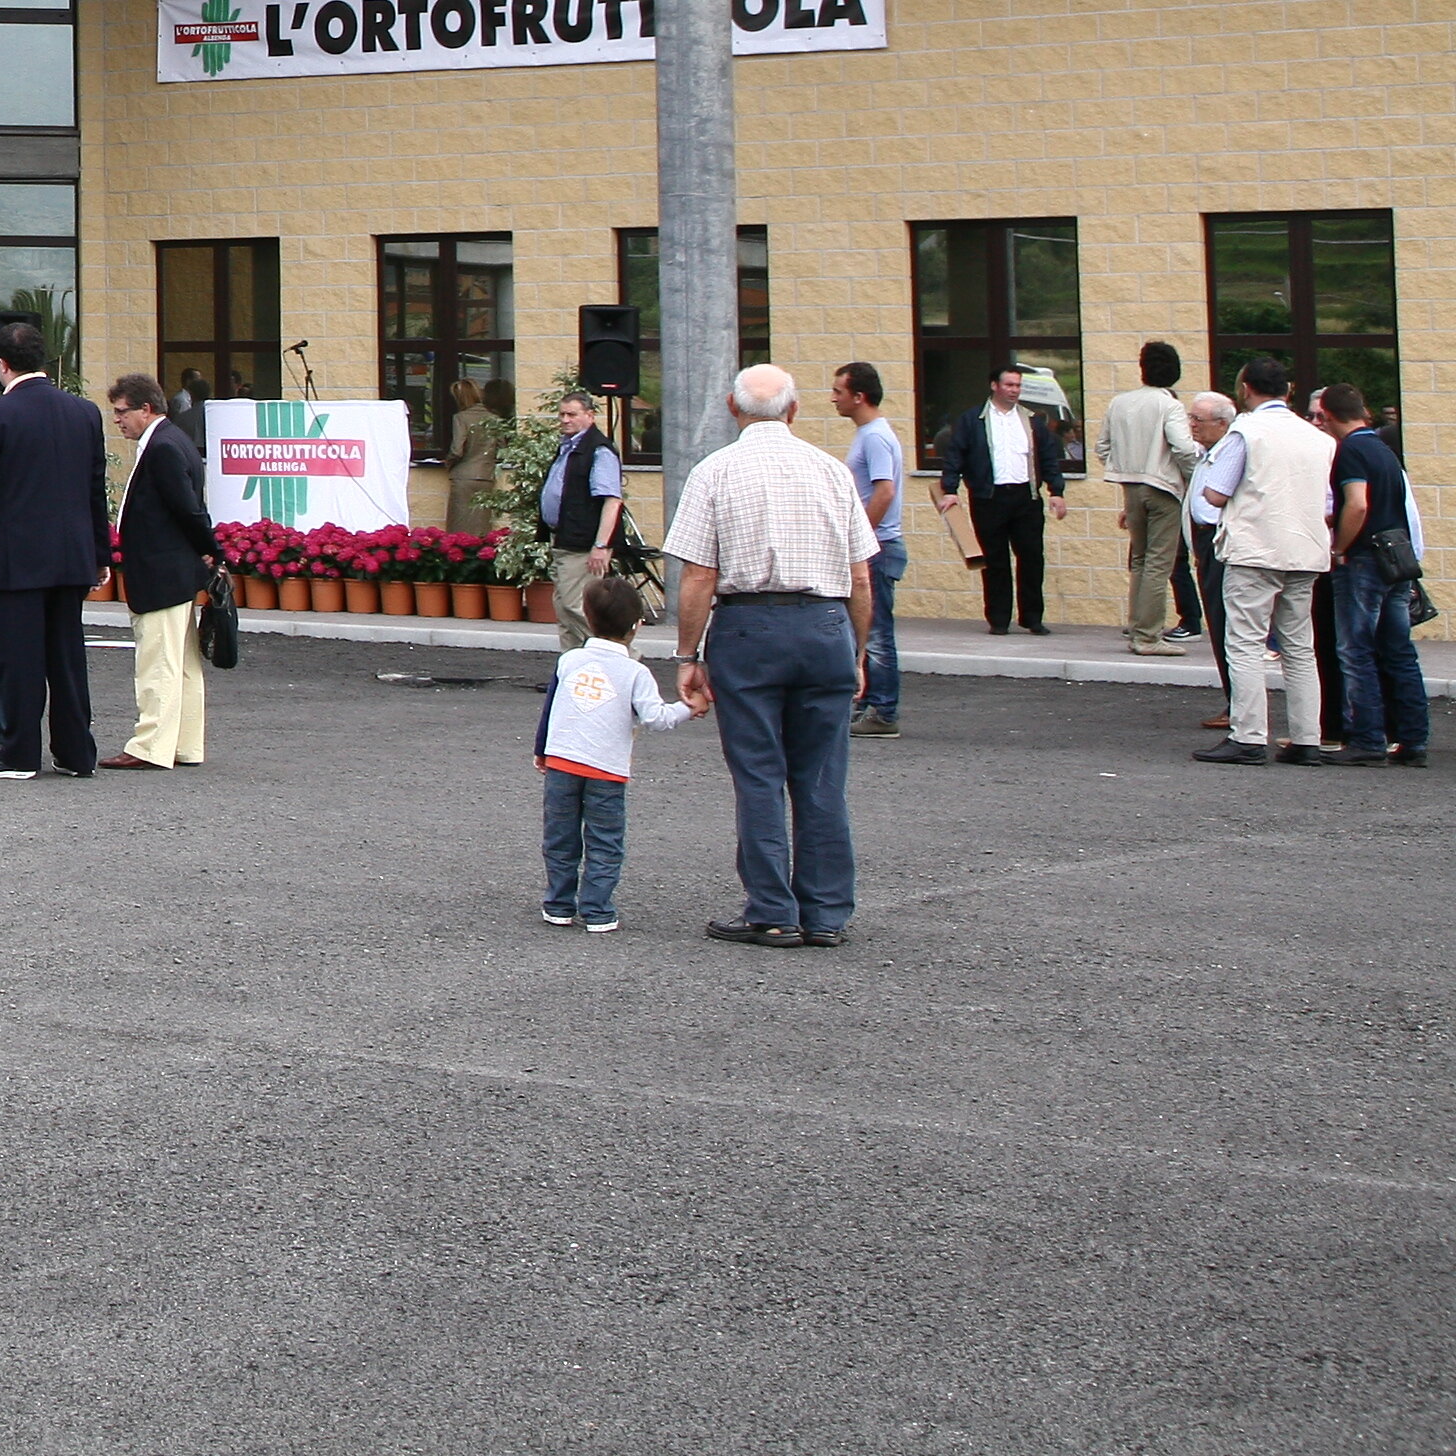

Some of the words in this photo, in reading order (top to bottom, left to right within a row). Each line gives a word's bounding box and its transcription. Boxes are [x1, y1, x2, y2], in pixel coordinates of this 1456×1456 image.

[176, 24, 257, 36] L'ORTOFRUTTICOLA
[222, 442, 363, 461] L'ORTOFRUTTICOLA
[259, 461, 308, 473] ALBENGA
[574, 672, 605, 701] 25
